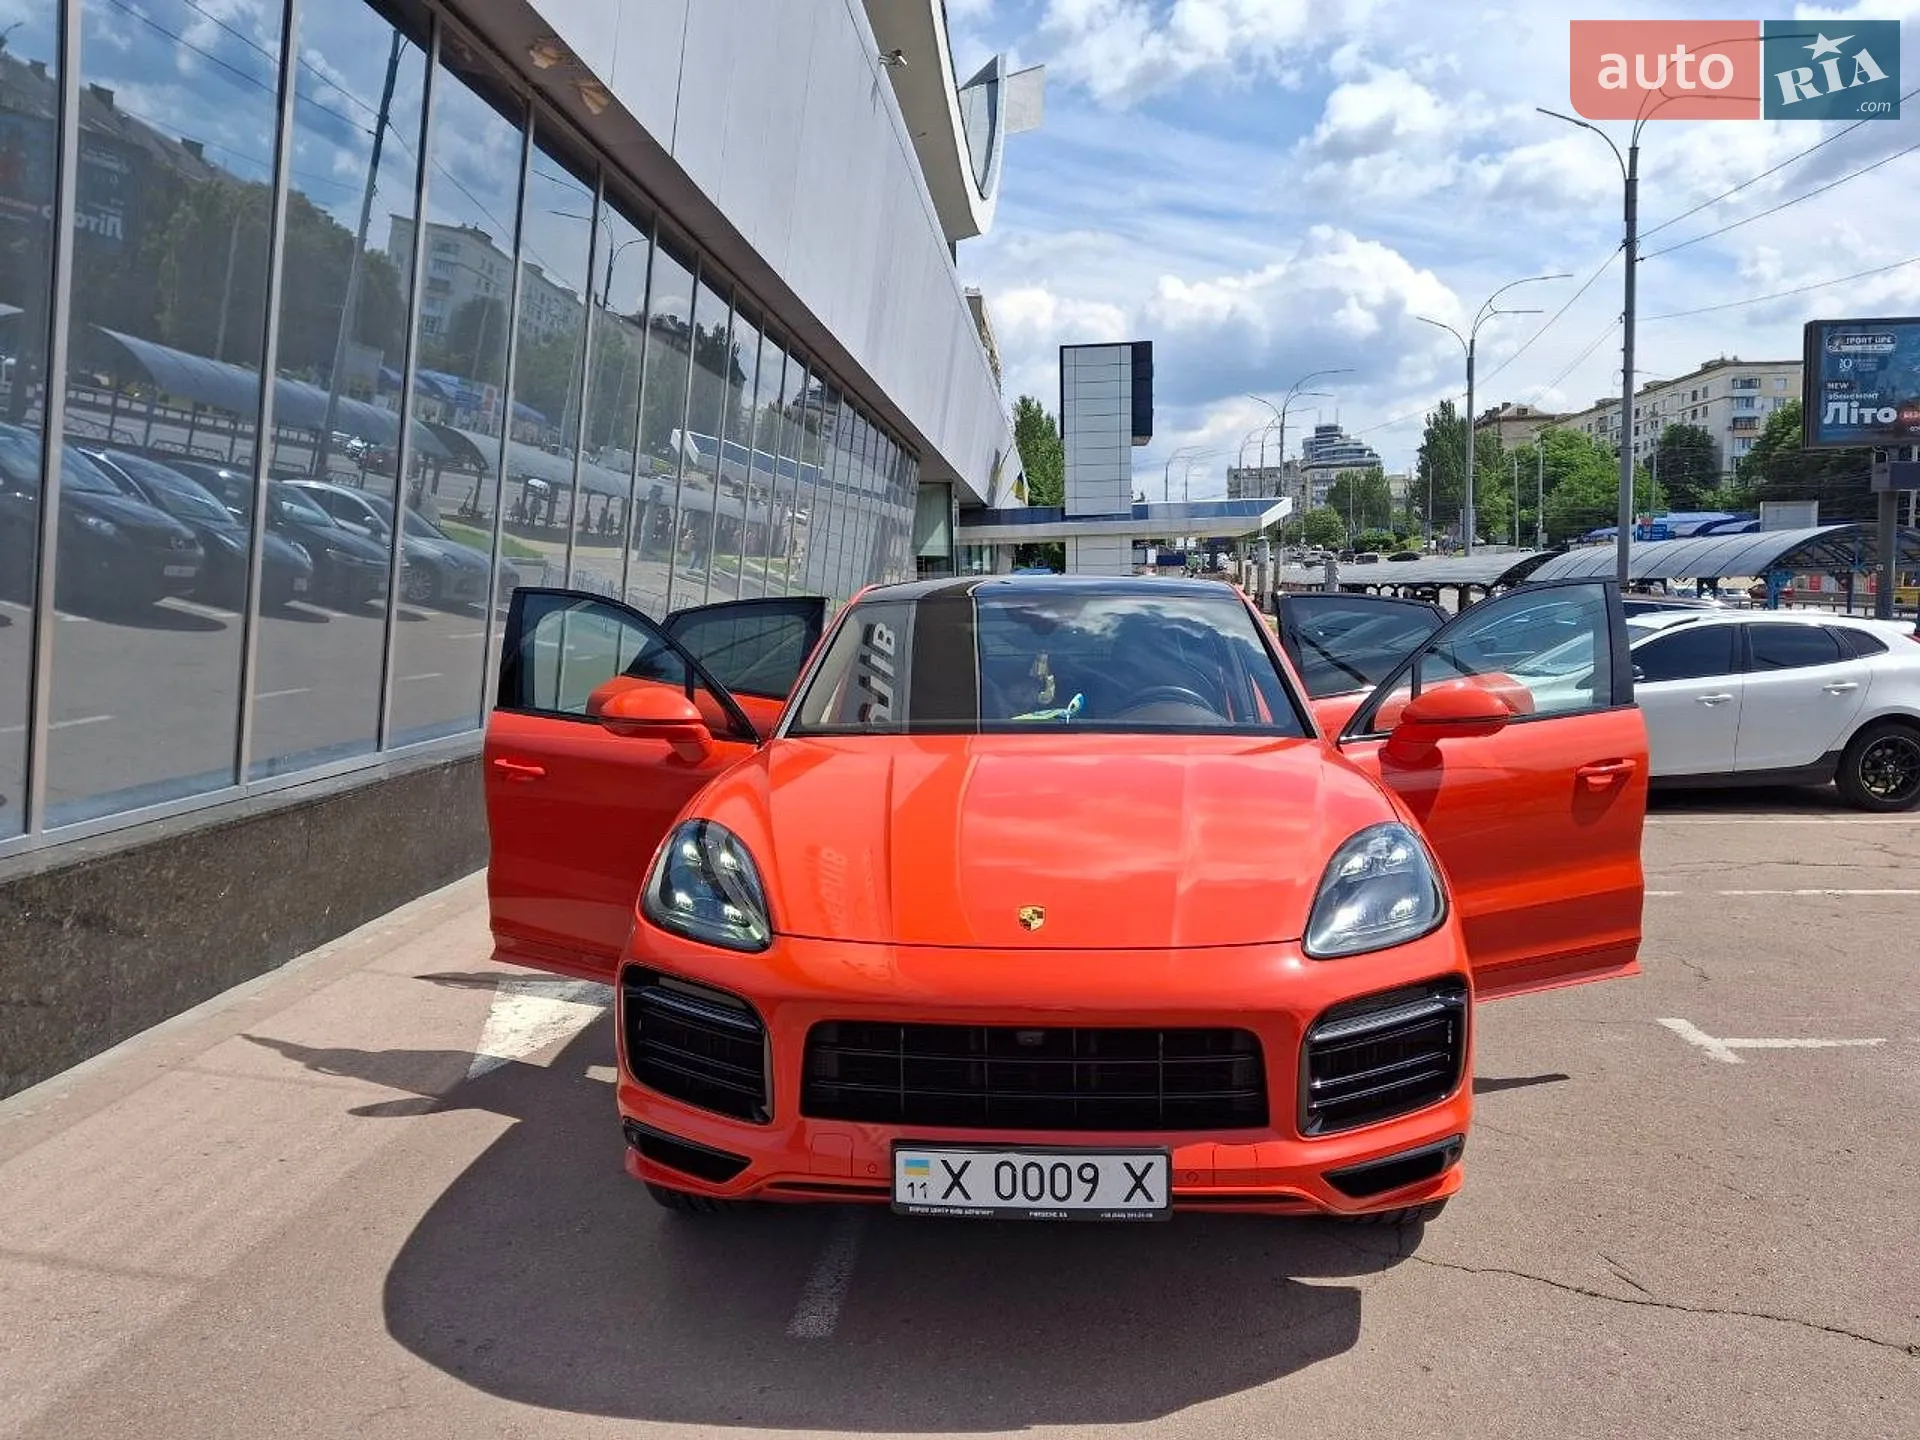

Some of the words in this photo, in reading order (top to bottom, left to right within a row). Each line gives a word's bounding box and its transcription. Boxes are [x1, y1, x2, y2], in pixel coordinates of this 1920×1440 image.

[1823, 400, 1898, 425] Літо
[906, 1182, 928, 1200] 11
[940, 1159, 972, 1201] X
[993, 1160, 1100, 1203] 0009
[1122, 1162, 1155, 1203] X
